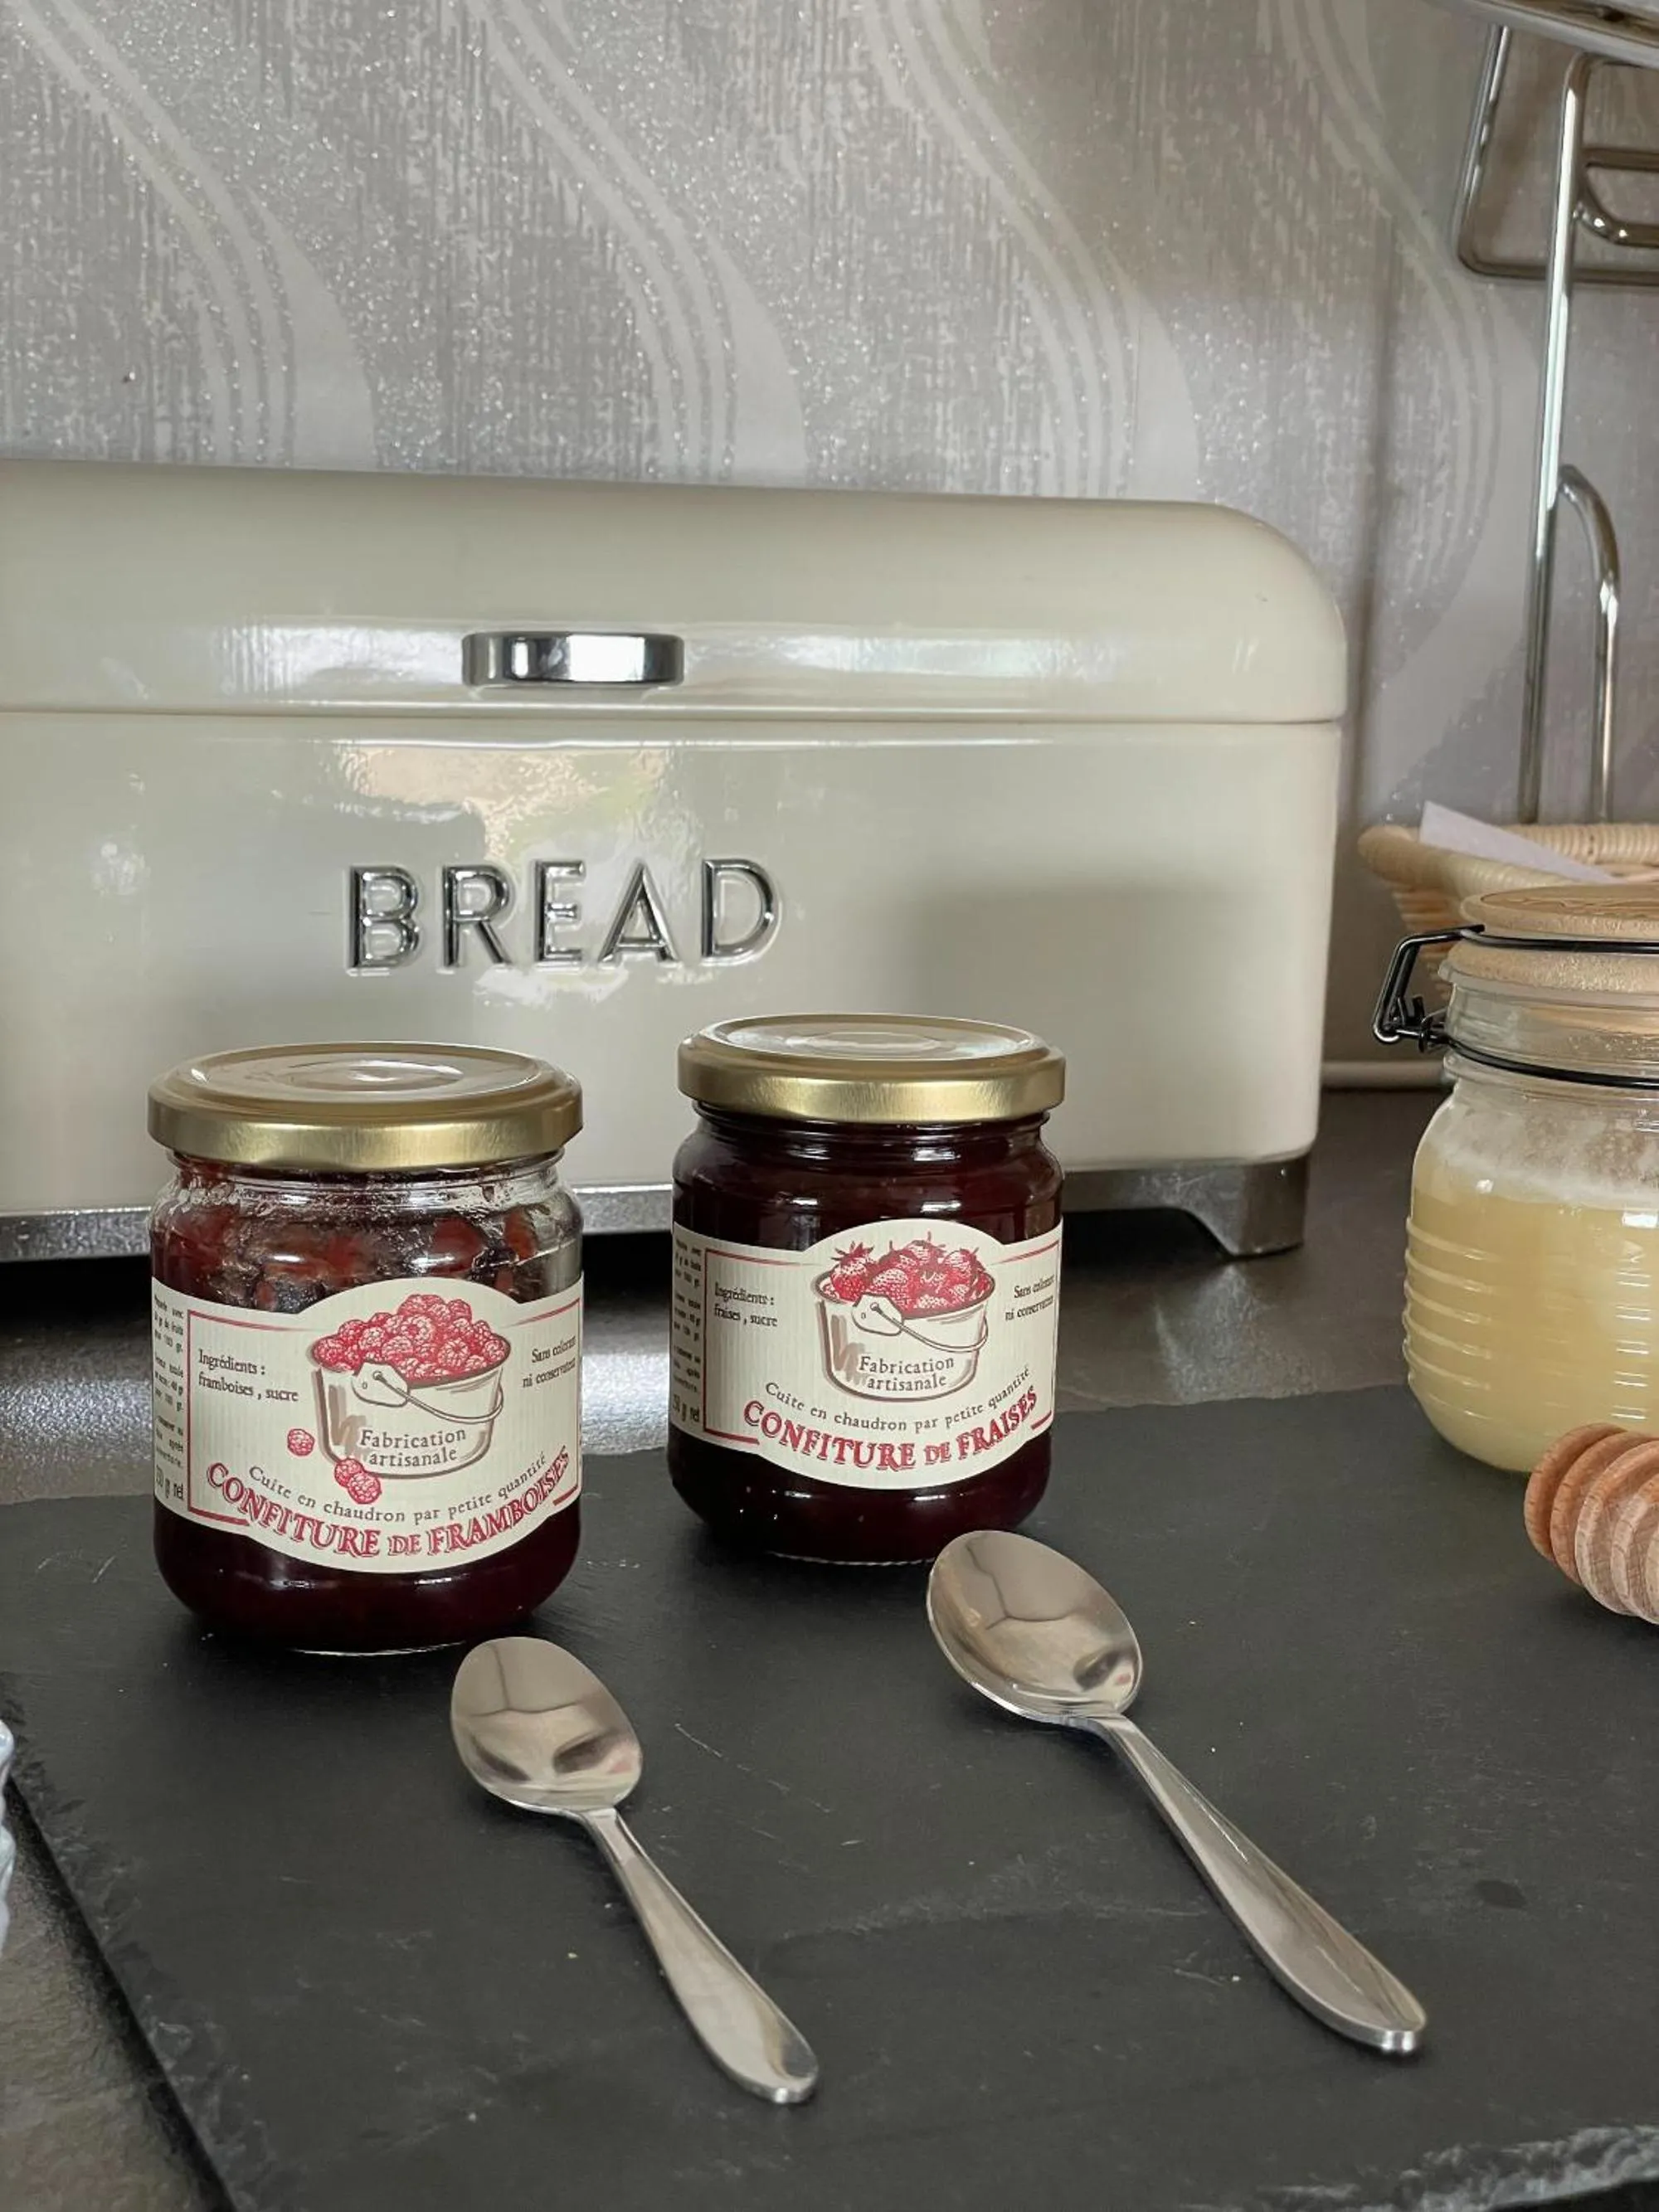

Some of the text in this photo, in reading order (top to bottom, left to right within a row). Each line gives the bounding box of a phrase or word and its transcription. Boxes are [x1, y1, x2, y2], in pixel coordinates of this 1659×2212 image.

[348, 858, 781, 972] BREAD
[714, 1281, 768, 1305] Ingrédients
[714, 1303, 741, 1321] fraises
[750, 1315, 778, 1327] sucre
[198, 1348, 258, 1375] Ingrédients
[859, 1355, 955, 1375] Fabrication
[198, 1371, 254, 1396] framboises
[265, 1388, 299, 1402] sucre
[867, 1373, 947, 1392] artisanale
[765, 1365, 1031, 1434] Cuite en chaudron par petite quantité
[360, 1428, 467, 1450] Fabrication
[743, 1385, 1038, 1472] CONFITURE DE FRAISES
[369, 1447, 458, 1467] artisanale
[249, 1451, 547, 1525] Cuite en chaudron par petite quantité
[207, 1446, 570, 1558] CONFITURE DE FRAMBOISES
